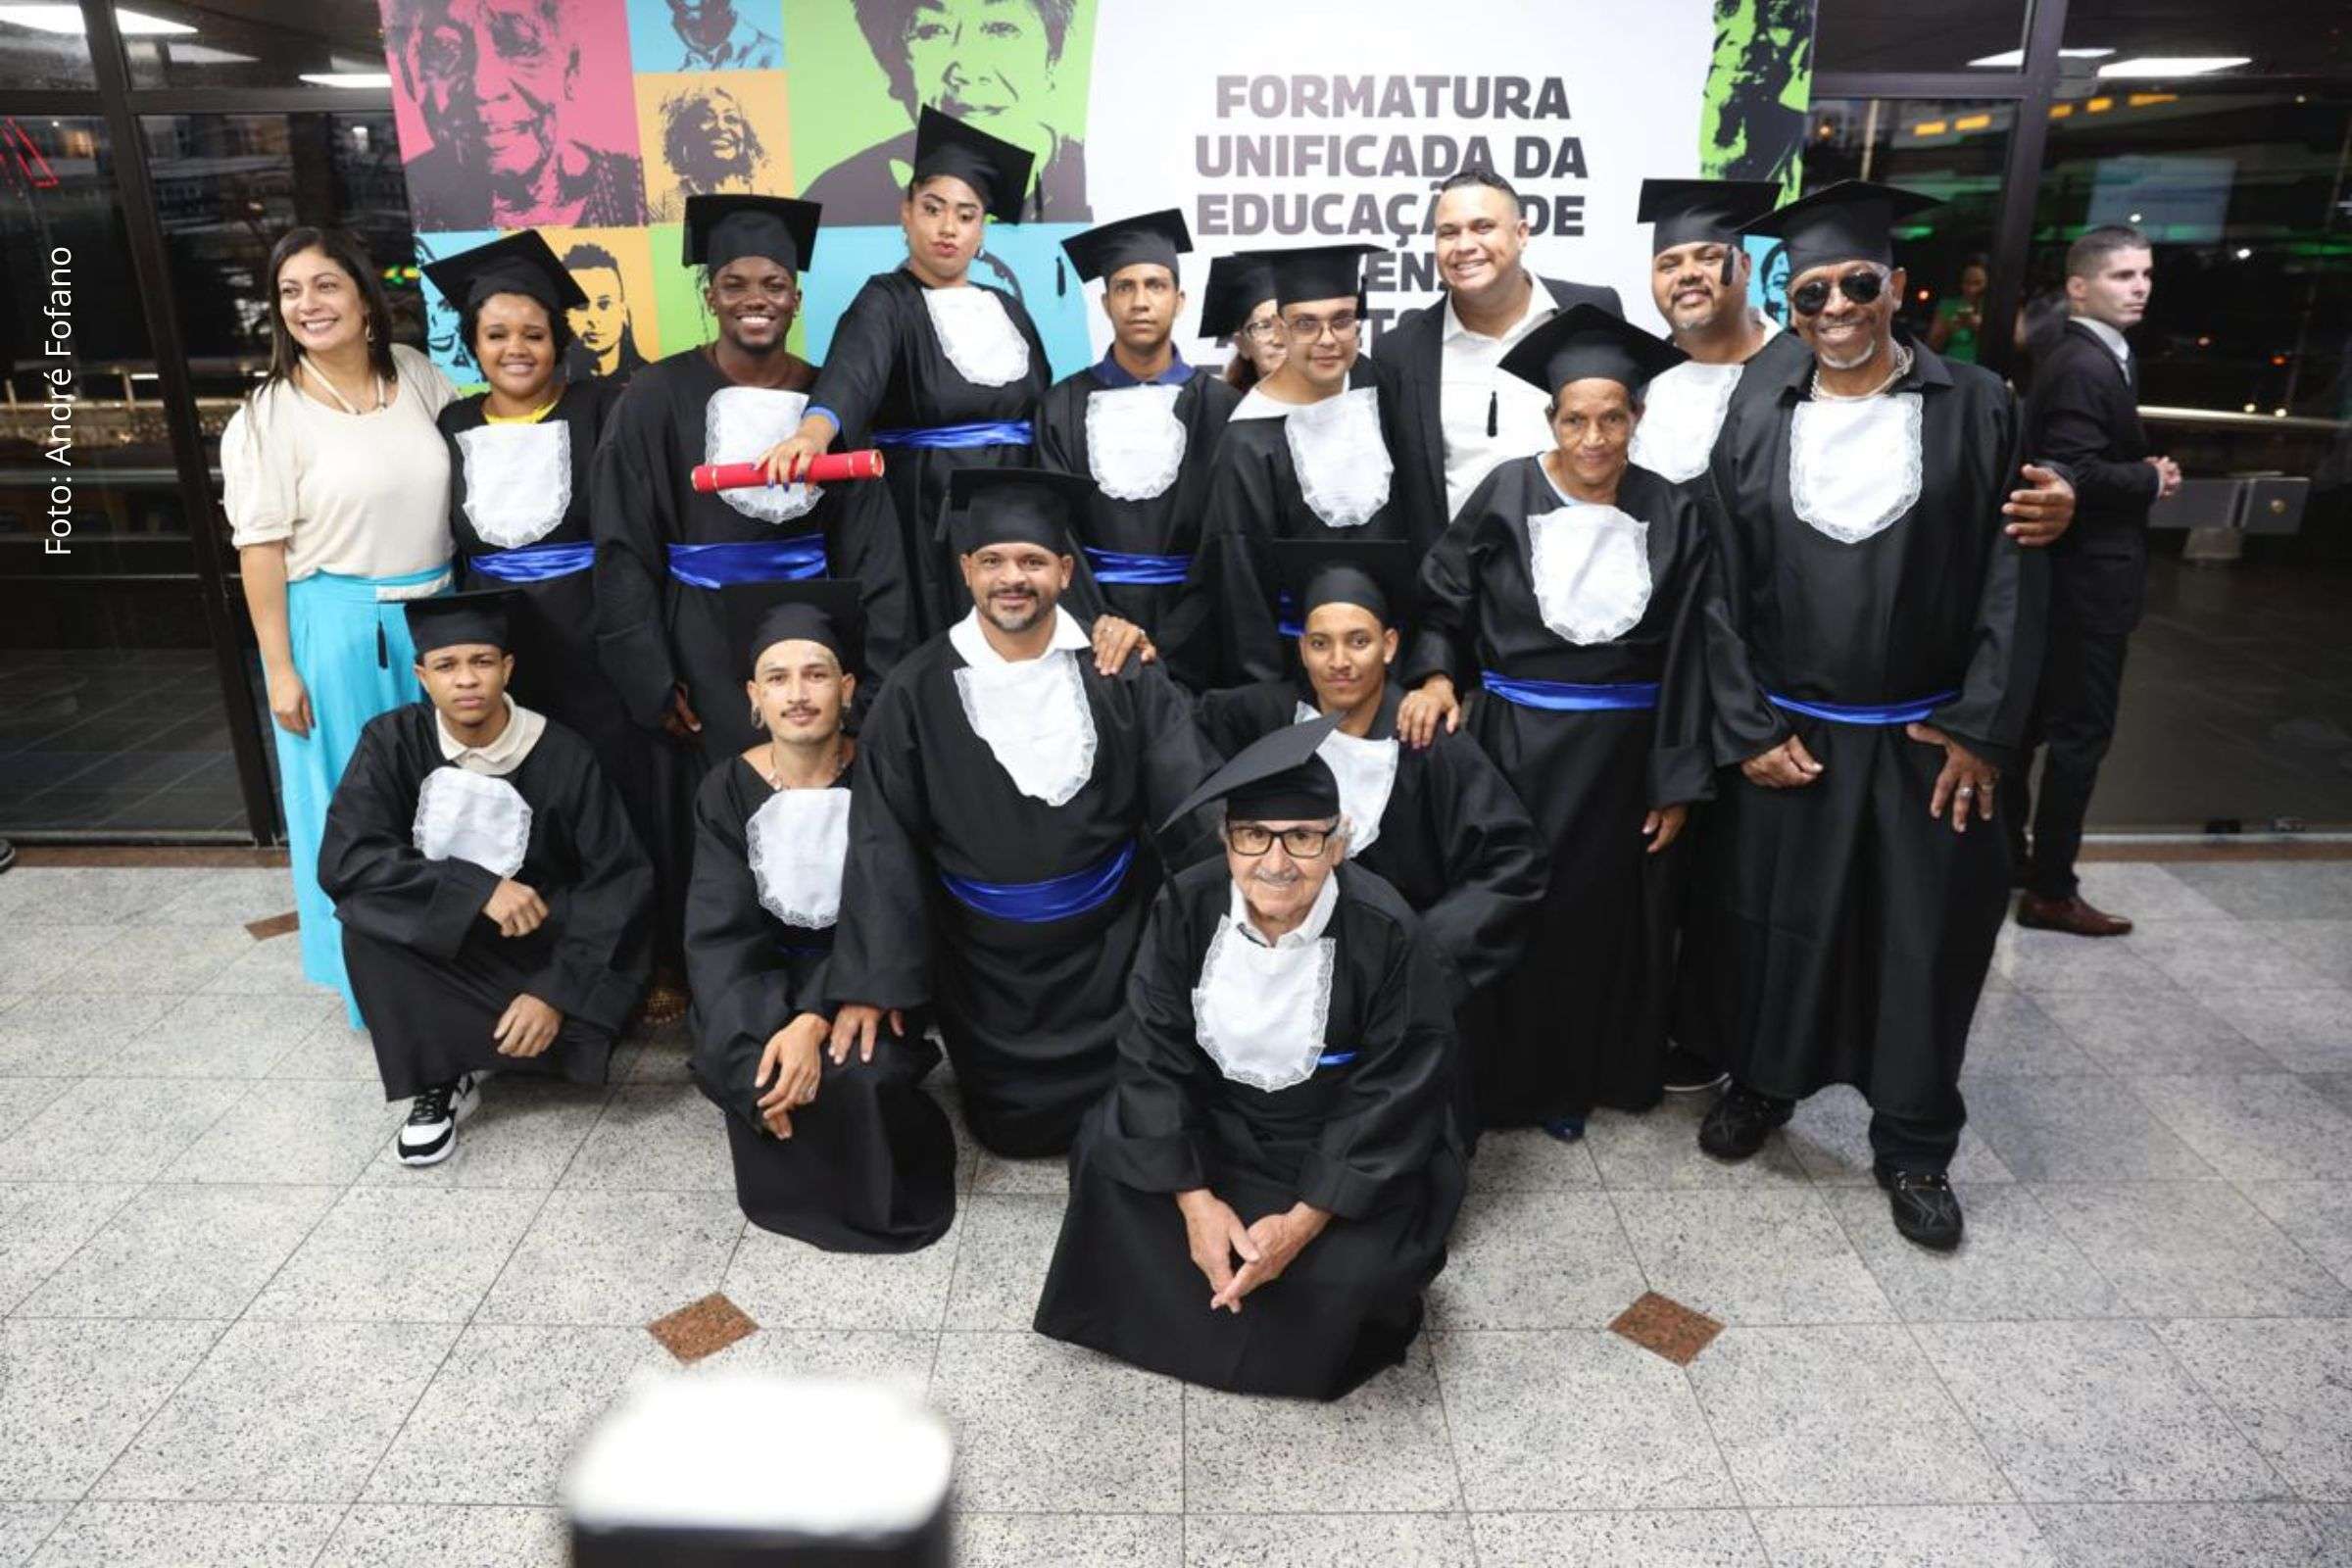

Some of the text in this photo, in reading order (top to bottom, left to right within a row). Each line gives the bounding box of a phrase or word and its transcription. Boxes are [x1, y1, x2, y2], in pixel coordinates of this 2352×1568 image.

[1215, 74, 1572, 120] FORMATURA
[1195, 134, 1589, 178] UNIFICADA DA
[1196, 180, 1585, 247] EDUCAÇ DE
